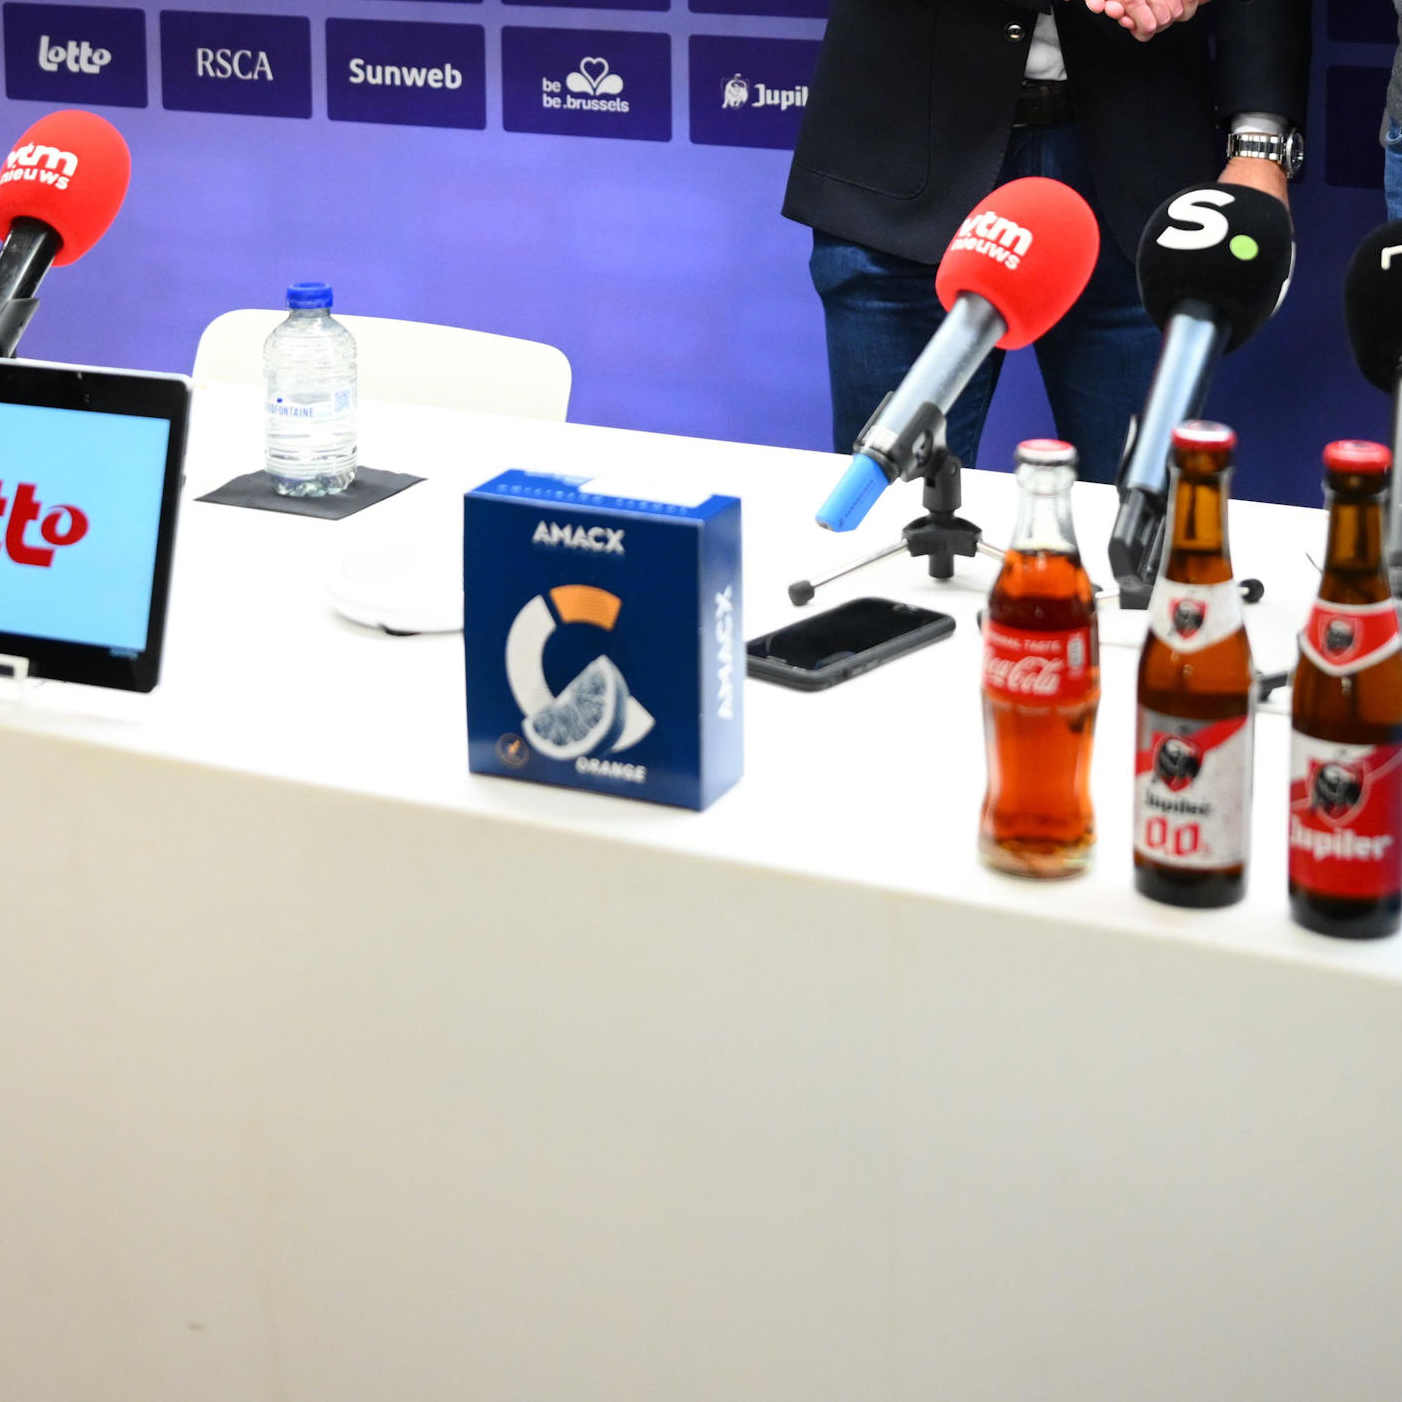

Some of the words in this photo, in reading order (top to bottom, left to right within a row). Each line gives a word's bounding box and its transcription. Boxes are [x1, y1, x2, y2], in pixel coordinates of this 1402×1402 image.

[196, 47, 274, 82] RSCA
[348, 57, 463, 90] Sunweb
[542, 78, 561, 93] be
[752, 83, 809, 111] Jupil
[6, 142, 79, 177] vtm
[958, 211, 1034, 256] vtm
[531, 519, 626, 556] AMACX
[574, 756, 647, 784] ORANGE
